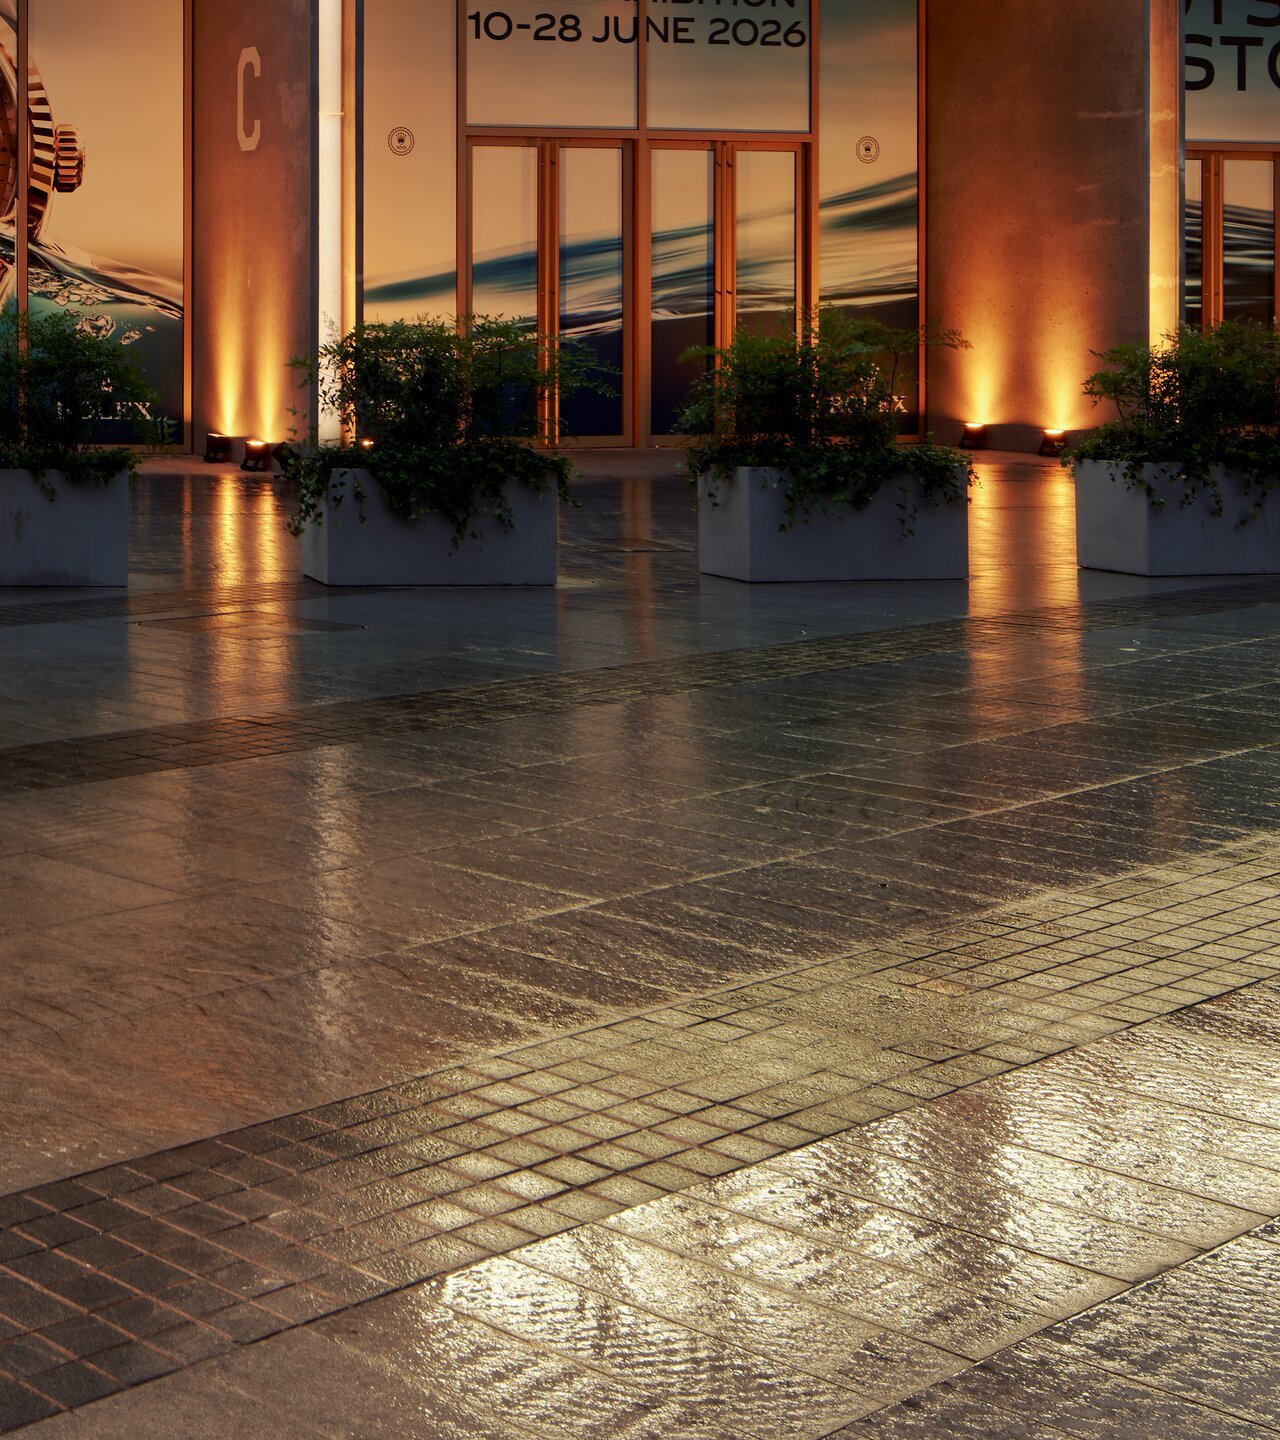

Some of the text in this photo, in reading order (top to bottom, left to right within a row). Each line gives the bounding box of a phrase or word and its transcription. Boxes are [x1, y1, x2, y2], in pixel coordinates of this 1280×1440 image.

[467, 11, 807, 48] 10-28 JUNE 2026
[237, 46, 261, 152] C
